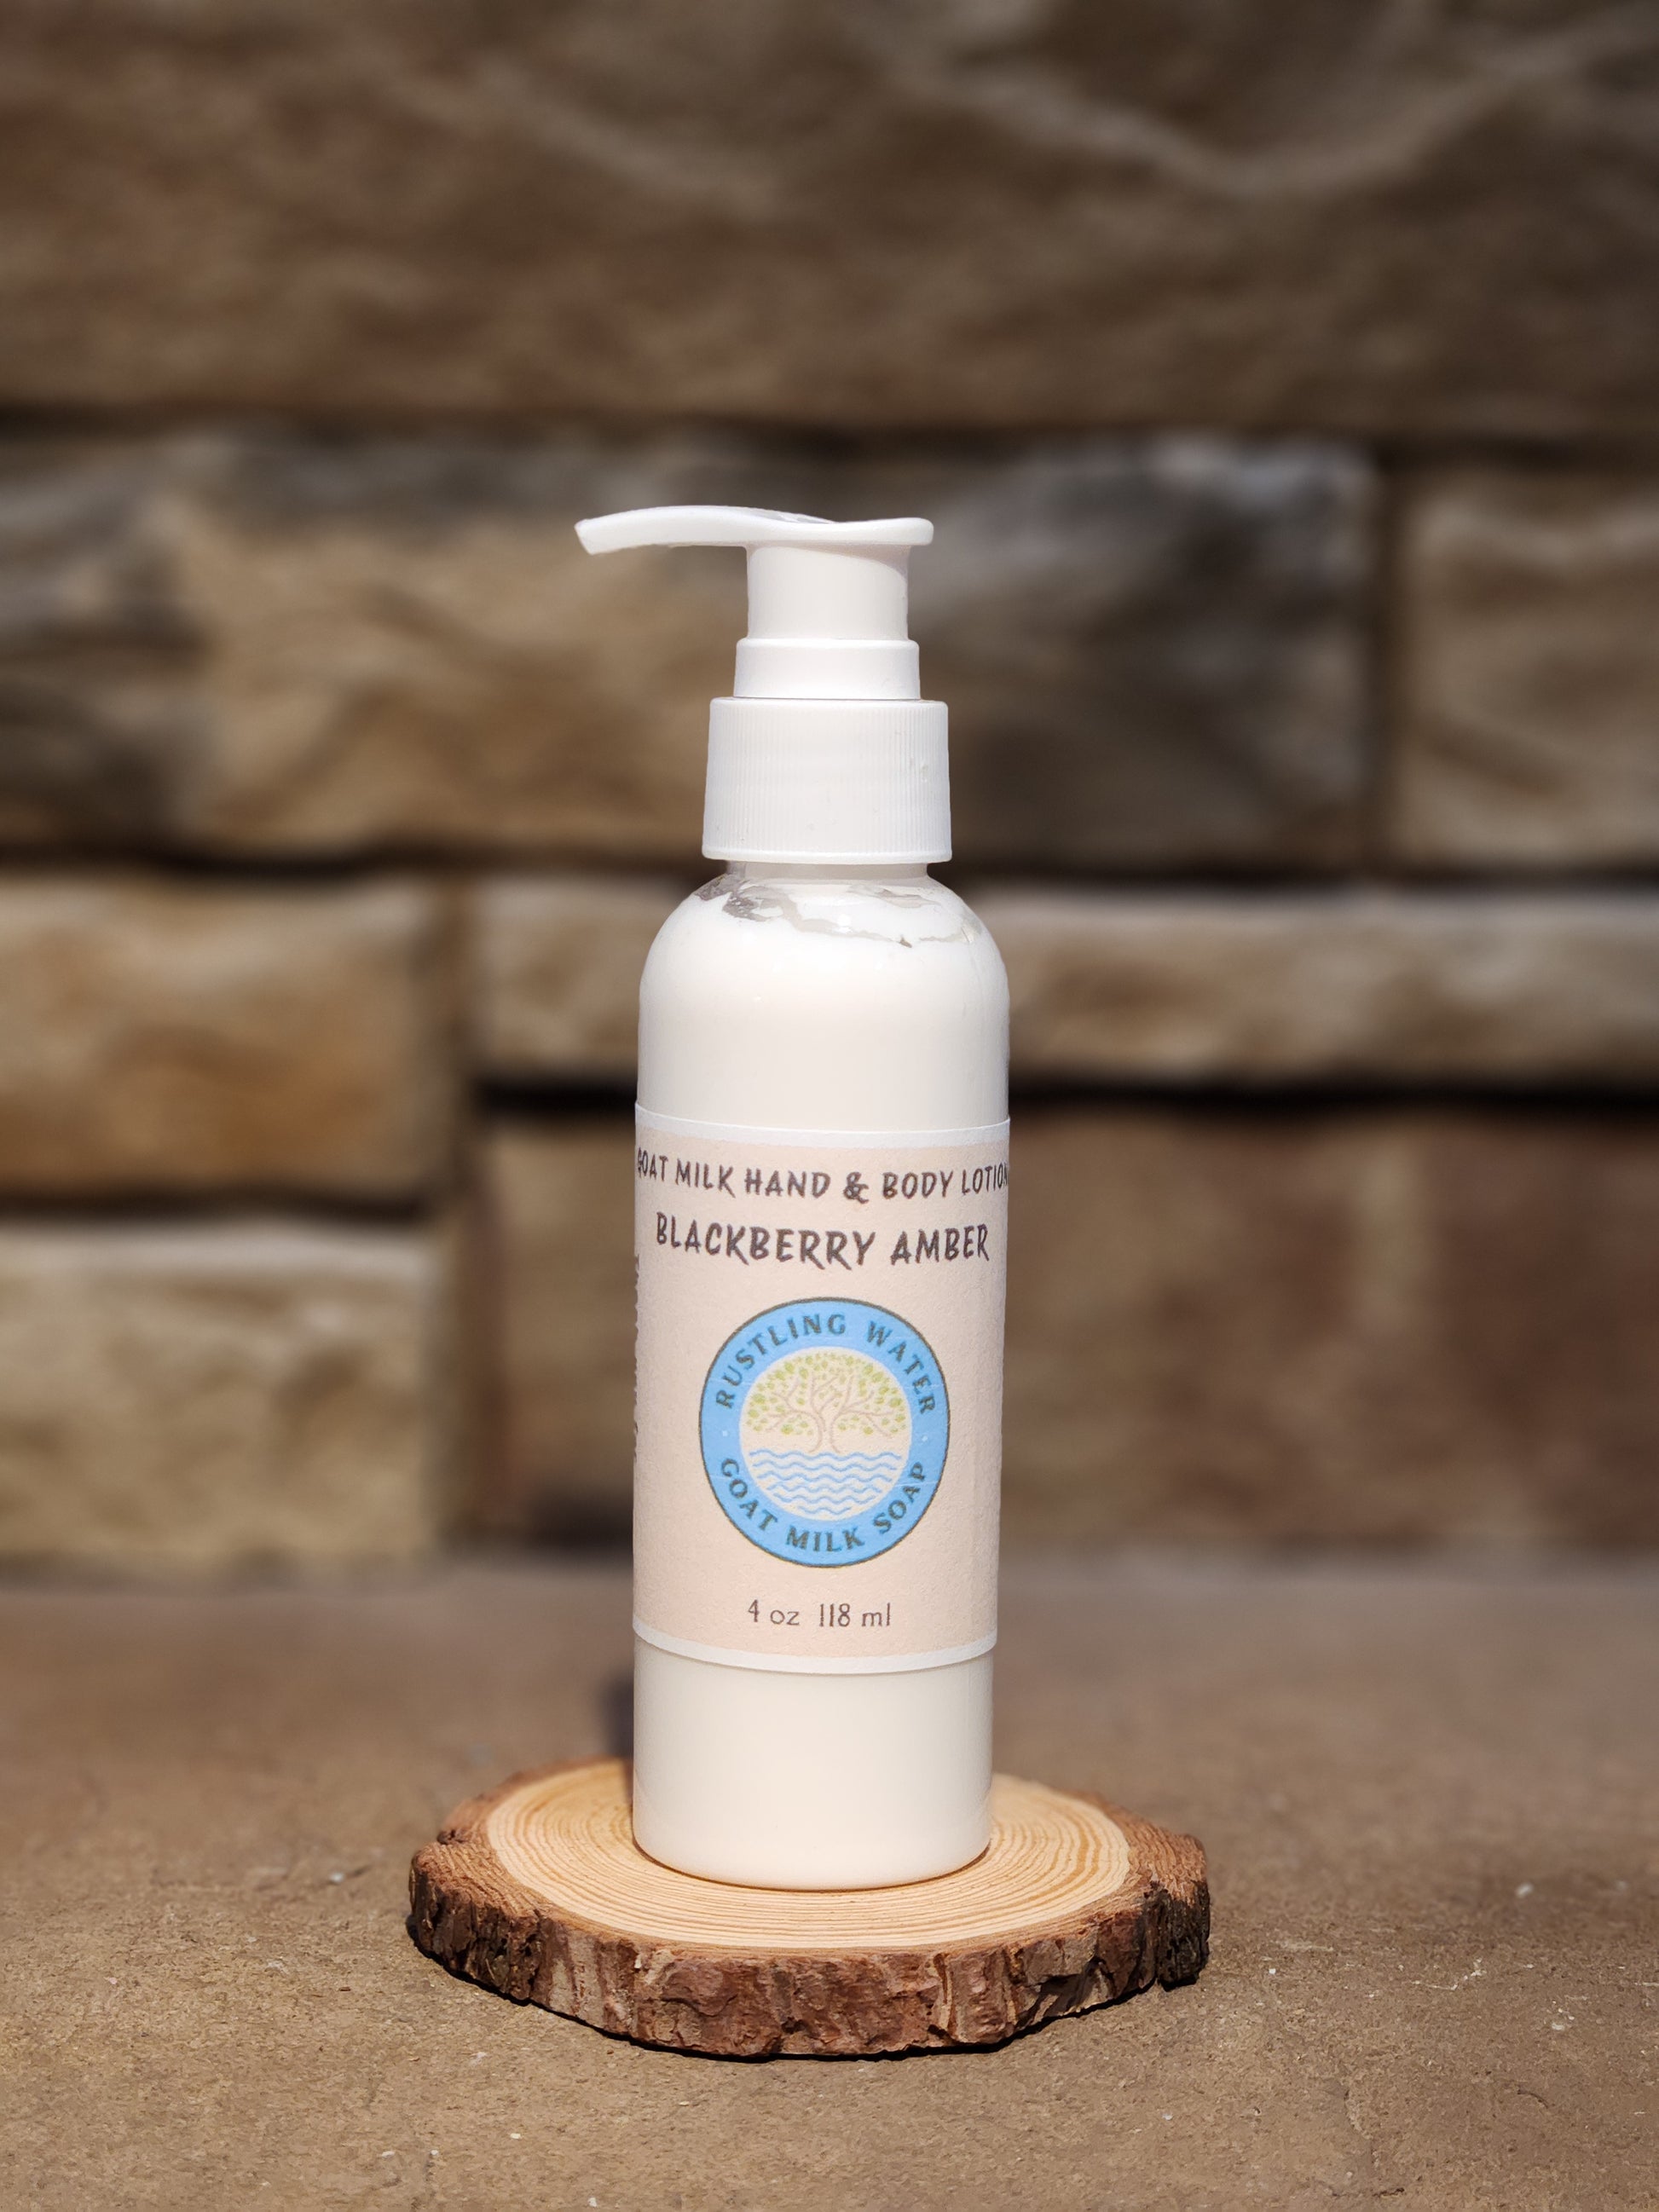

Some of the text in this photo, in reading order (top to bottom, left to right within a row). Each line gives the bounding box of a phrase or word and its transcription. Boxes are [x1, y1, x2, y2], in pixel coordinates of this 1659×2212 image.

[675, 1158, 736, 1198] MILK
[743, 1167, 831, 1199] HAND
[841, 1170, 870, 1204] &
[882, 1170, 954, 1199] BODY
[656, 1211, 990, 1271] BLACKBERRY AMBER
[715, 1314, 847, 1409] RUSTLING
[864, 1320, 936, 1414] WATER
[720, 1458, 926, 1552] GOAT MILK SOAP
[748, 1599, 891, 1627] 4 oz 118 ml
